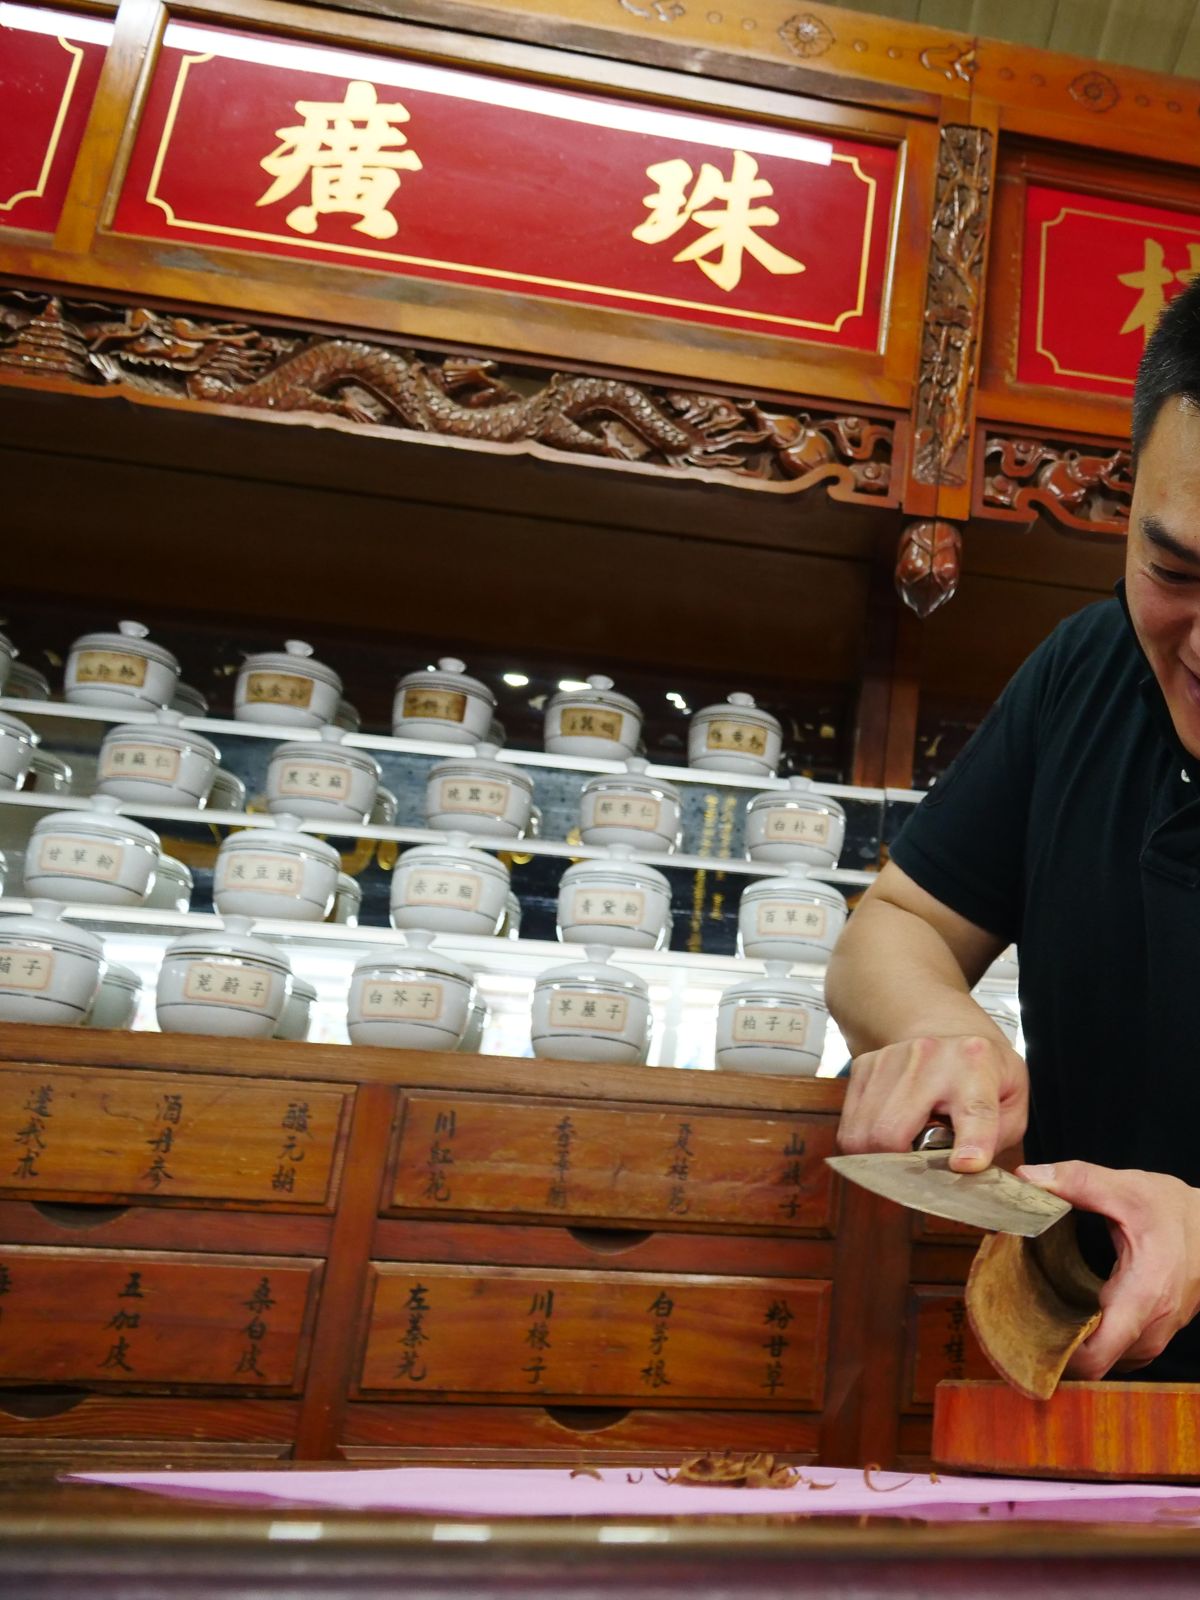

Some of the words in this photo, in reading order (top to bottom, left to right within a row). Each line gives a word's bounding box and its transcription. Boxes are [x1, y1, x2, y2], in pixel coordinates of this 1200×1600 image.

[287, 771, 343, 789] 黑芝麻
[47, 847, 115, 870] 甘草粉
[368, 989, 435, 1009] 白芥子
[742, 1015, 801, 1033] 柏子仁
[142, 1094, 183, 1191] 酒丹參
[423, 1108, 457, 1203] 川紅花
[98, 1271, 145, 1372] 五加皮
[235, 1276, 278, 1377] 桑白皮
[640, 1290, 675, 1389] 白茅根
[761, 1300, 794, 1396] 粉甘草
